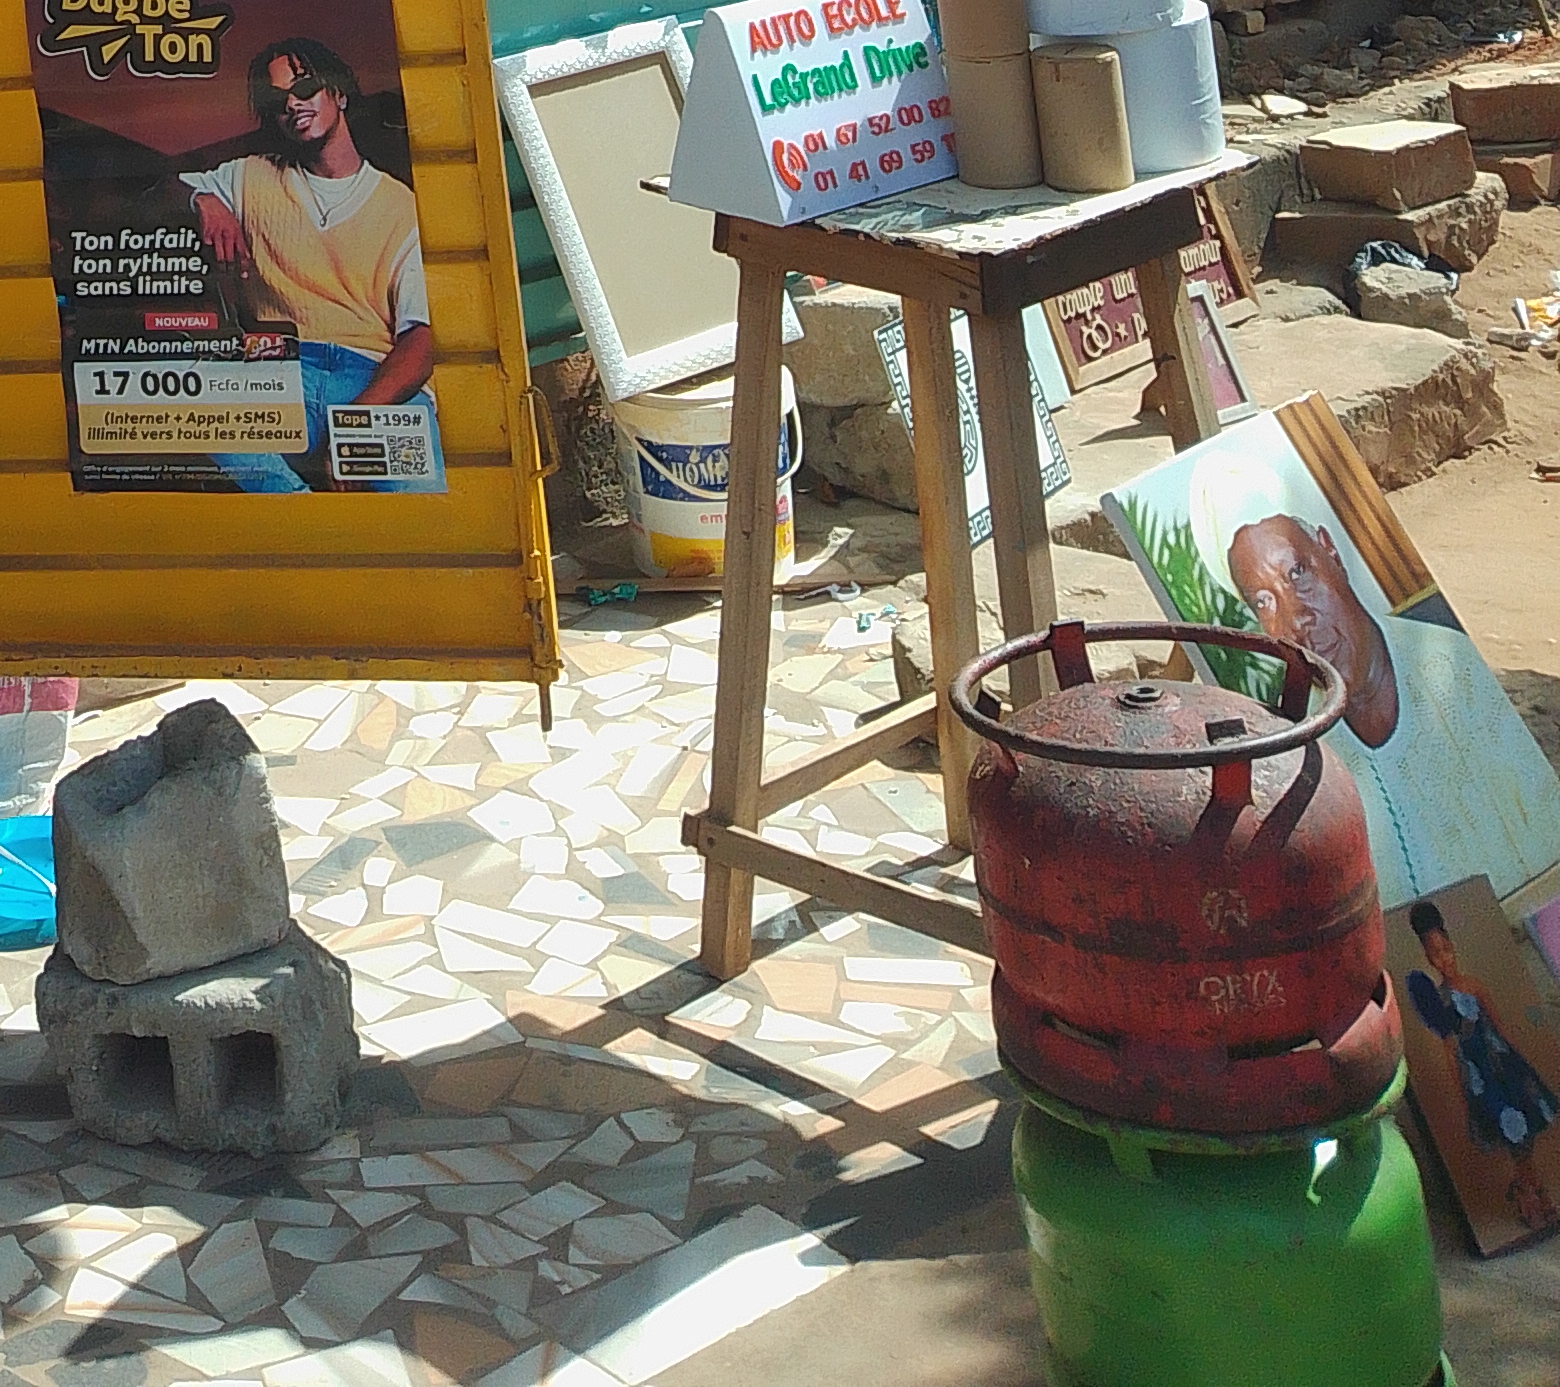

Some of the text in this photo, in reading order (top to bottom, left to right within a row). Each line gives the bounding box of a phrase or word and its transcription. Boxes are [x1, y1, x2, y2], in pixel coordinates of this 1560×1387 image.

[135, 24, 214, 64] Ton
[748, 7, 816, 55] AUTO
[751, 37, 930, 113] LeGrand Drive
[803, 95, 952, 155] 01 67 52 00 82
[813, 138, 936, 193] 01 41 69 59
[71, 226, 202, 253] Ton forfait,
[72, 251, 210, 280] ton rythme,
[75, 274, 204, 297] sans limite
[154, 315, 210, 329] NOUVEAU
[80, 338, 120, 355] MTN
[123, 335, 240, 356] Abonnement
[91, 369, 285, 398] 17 000 Fcfa /mois
[103, 410, 172, 427] (Internet
[185, 410, 232, 428] Appel
[335, 411, 370, 427] Tape
[87, 425, 303, 442] illimité vers tous les réseaux
[699, 512, 727, 524] em
